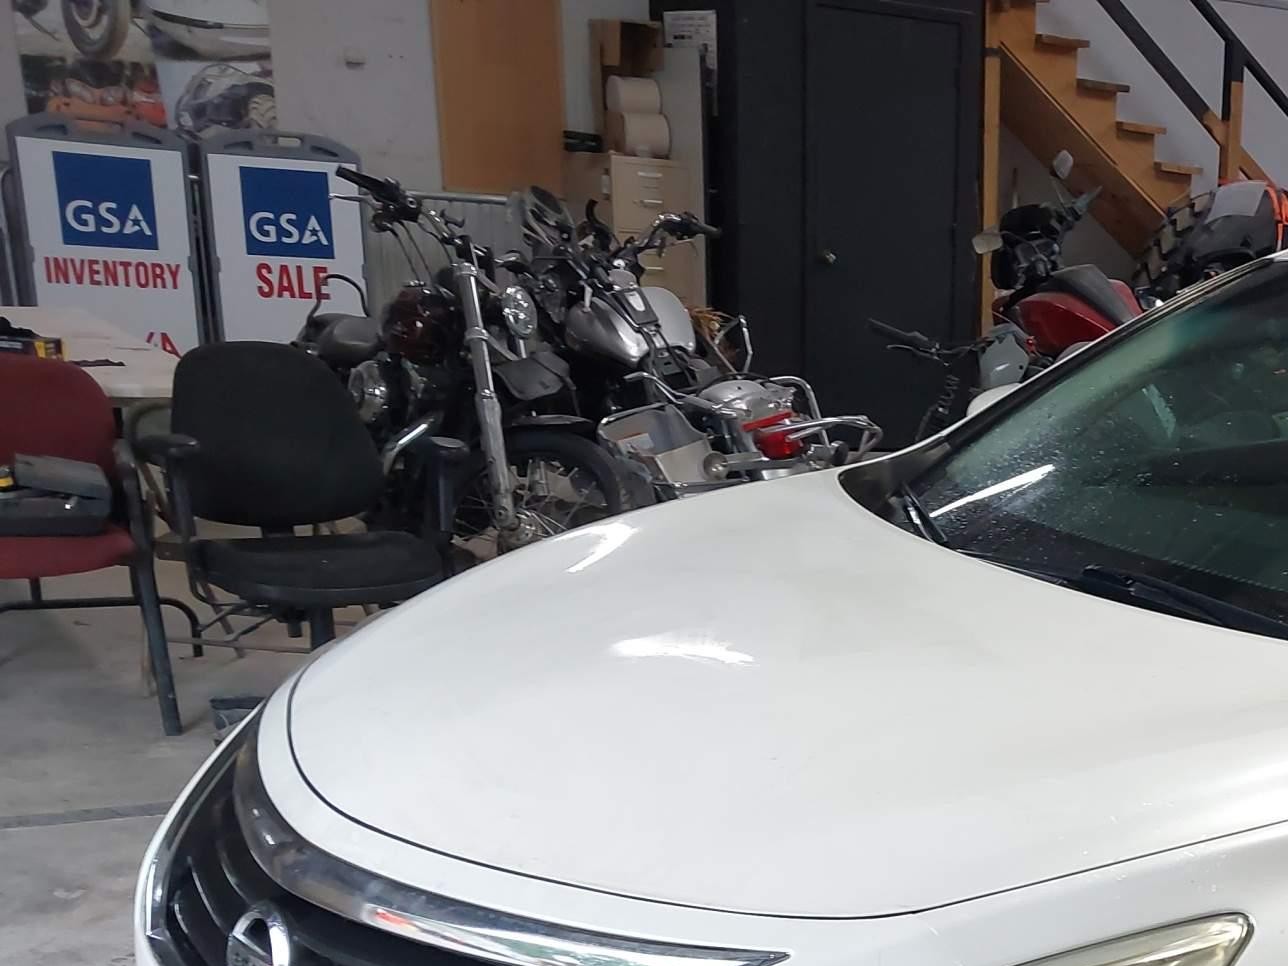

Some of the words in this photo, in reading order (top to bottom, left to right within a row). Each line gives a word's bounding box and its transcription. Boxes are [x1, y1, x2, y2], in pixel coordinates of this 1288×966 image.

[65, 199, 153, 236] GSA
[249, 211, 329, 246] GSA
[44, 255, 181, 290] INVENTORY
[255, 262, 331, 300] SALE
